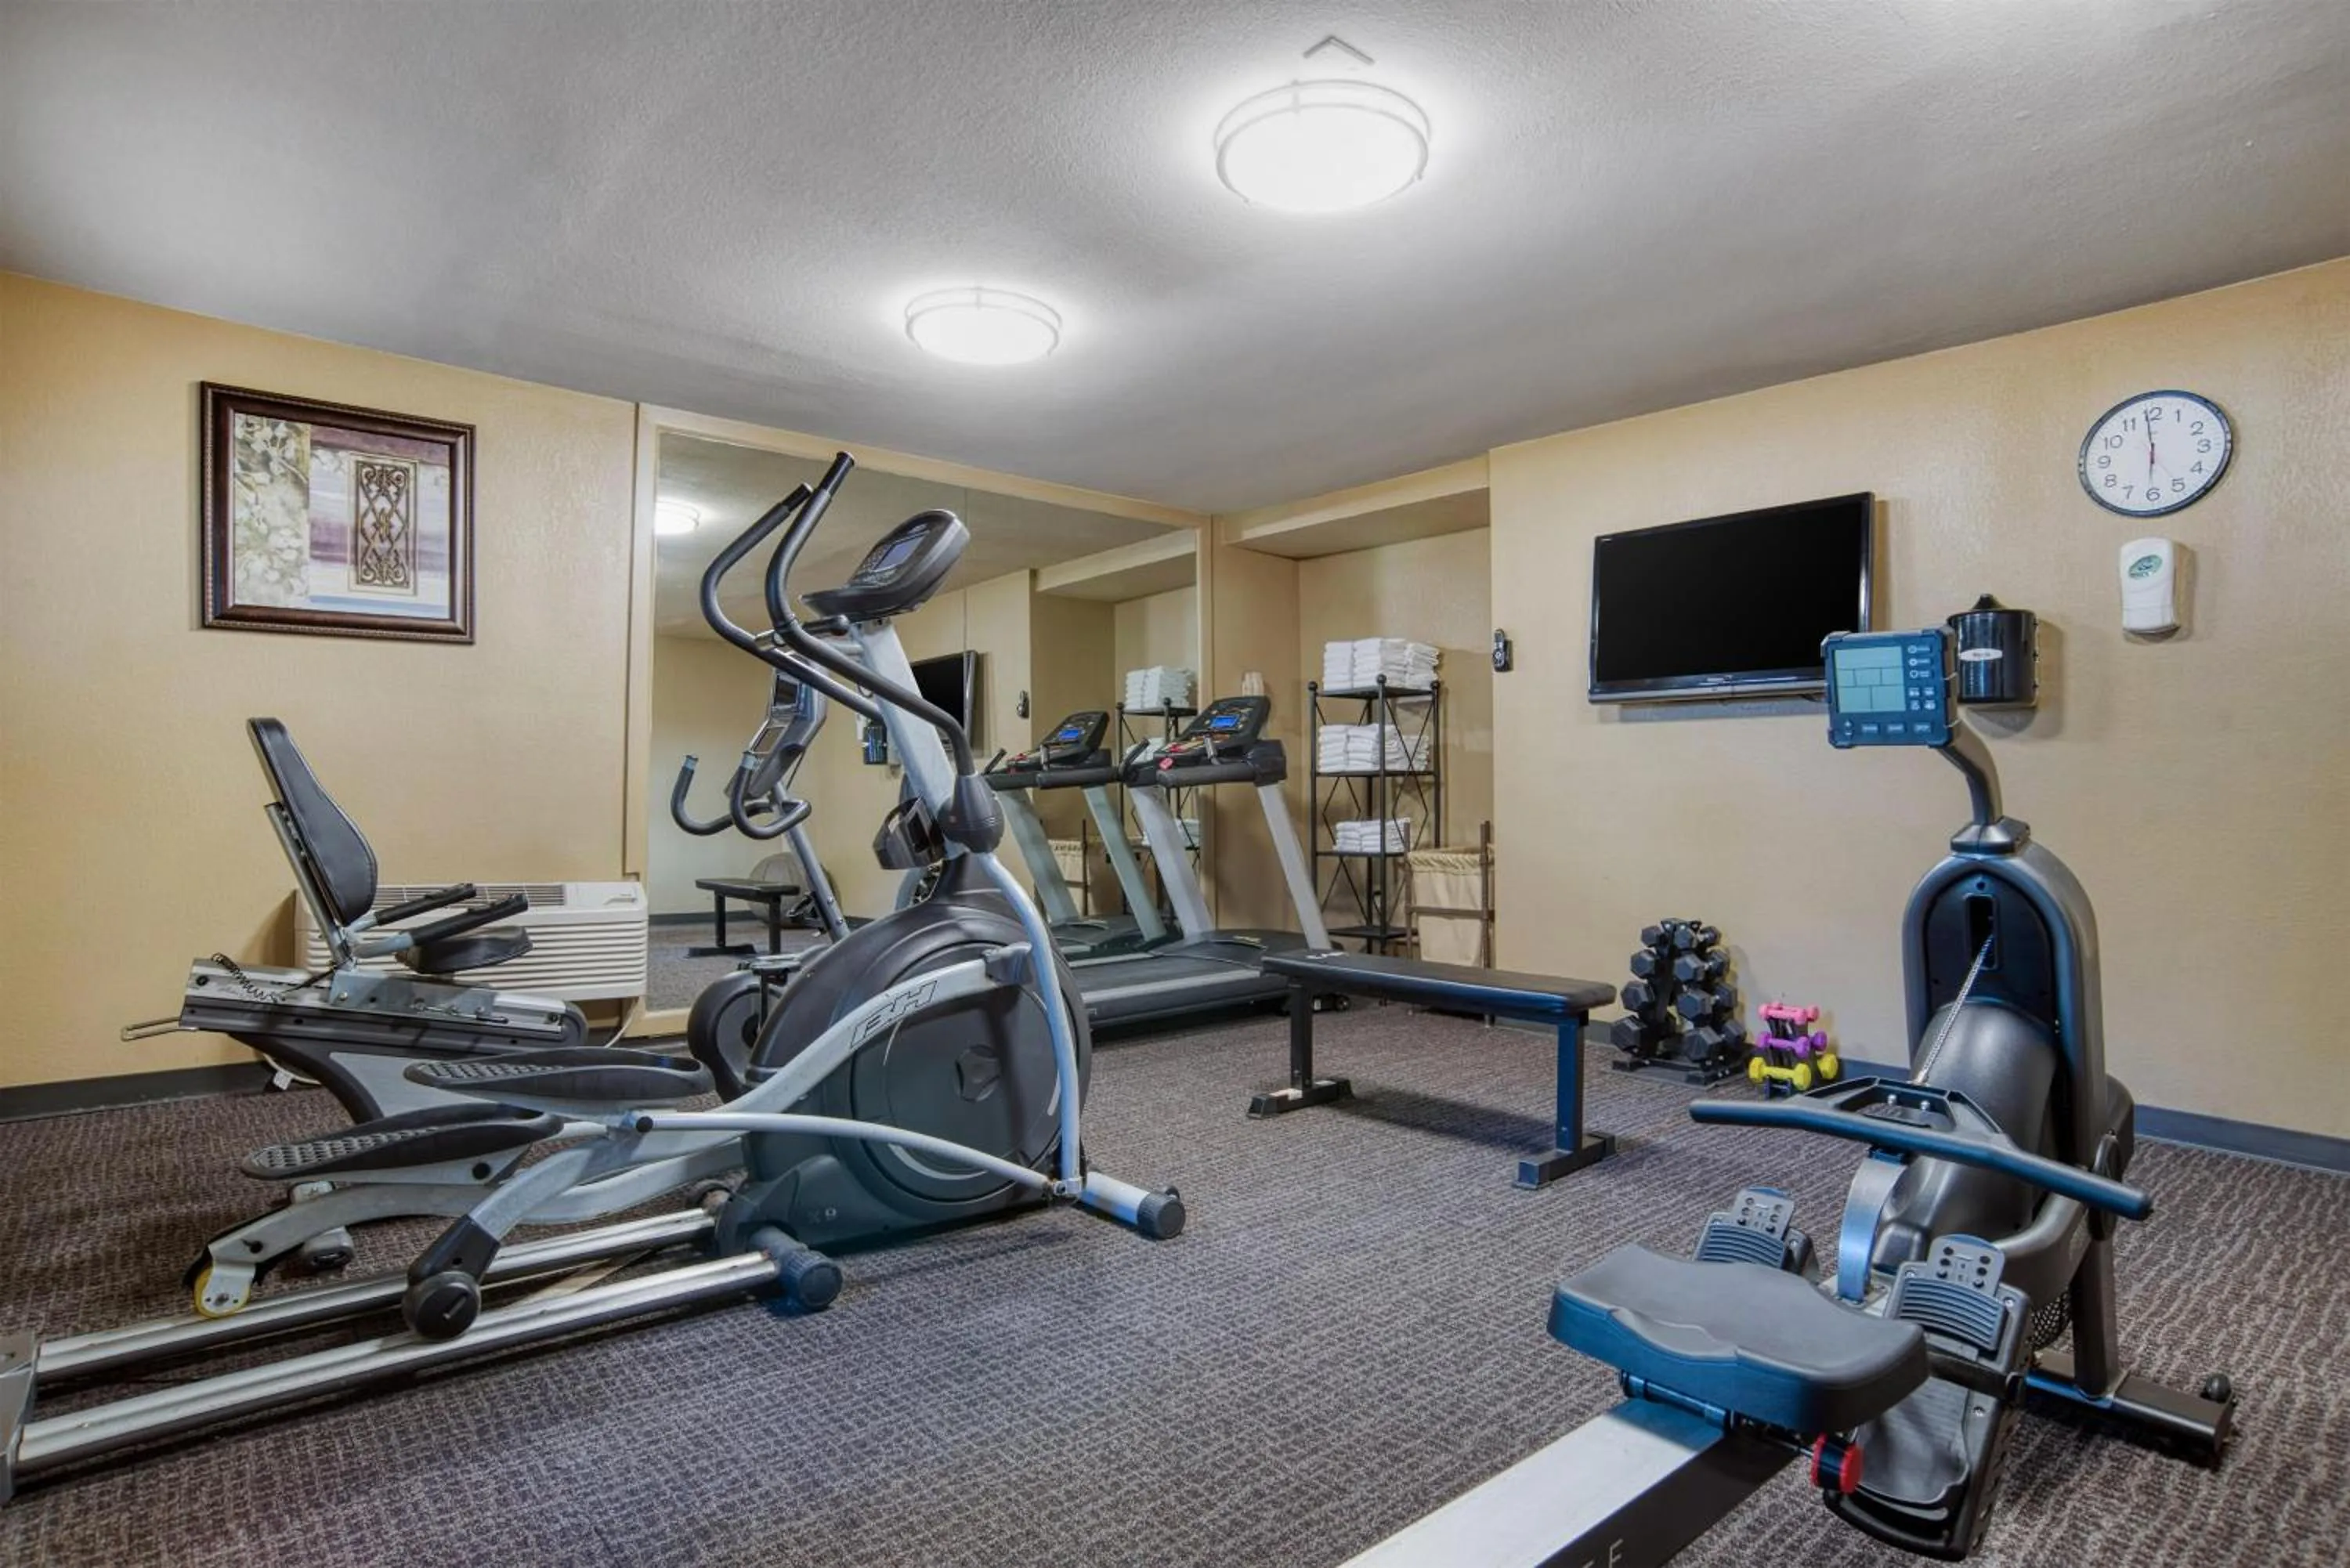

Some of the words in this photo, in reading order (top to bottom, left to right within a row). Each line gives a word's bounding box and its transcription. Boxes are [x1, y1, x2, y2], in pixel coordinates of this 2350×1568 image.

[2142, 407, 2162, 421] 12
[2175, 409, 2182, 423] 1
[2122, 417, 2137, 432] 11
[2190, 421, 2204, 436] 2
[2103, 435, 2123, 450] 10
[2196, 439, 2212, 453] 3
[2097, 455, 2112, 469] 9
[2190, 461, 2204, 475] 4
[2105, 474, 2117, 488] 8
[2171, 477, 2186, 493] 5
[2121, 485, 2135, 500] 7
[2146, 488, 2161, 502] 6
